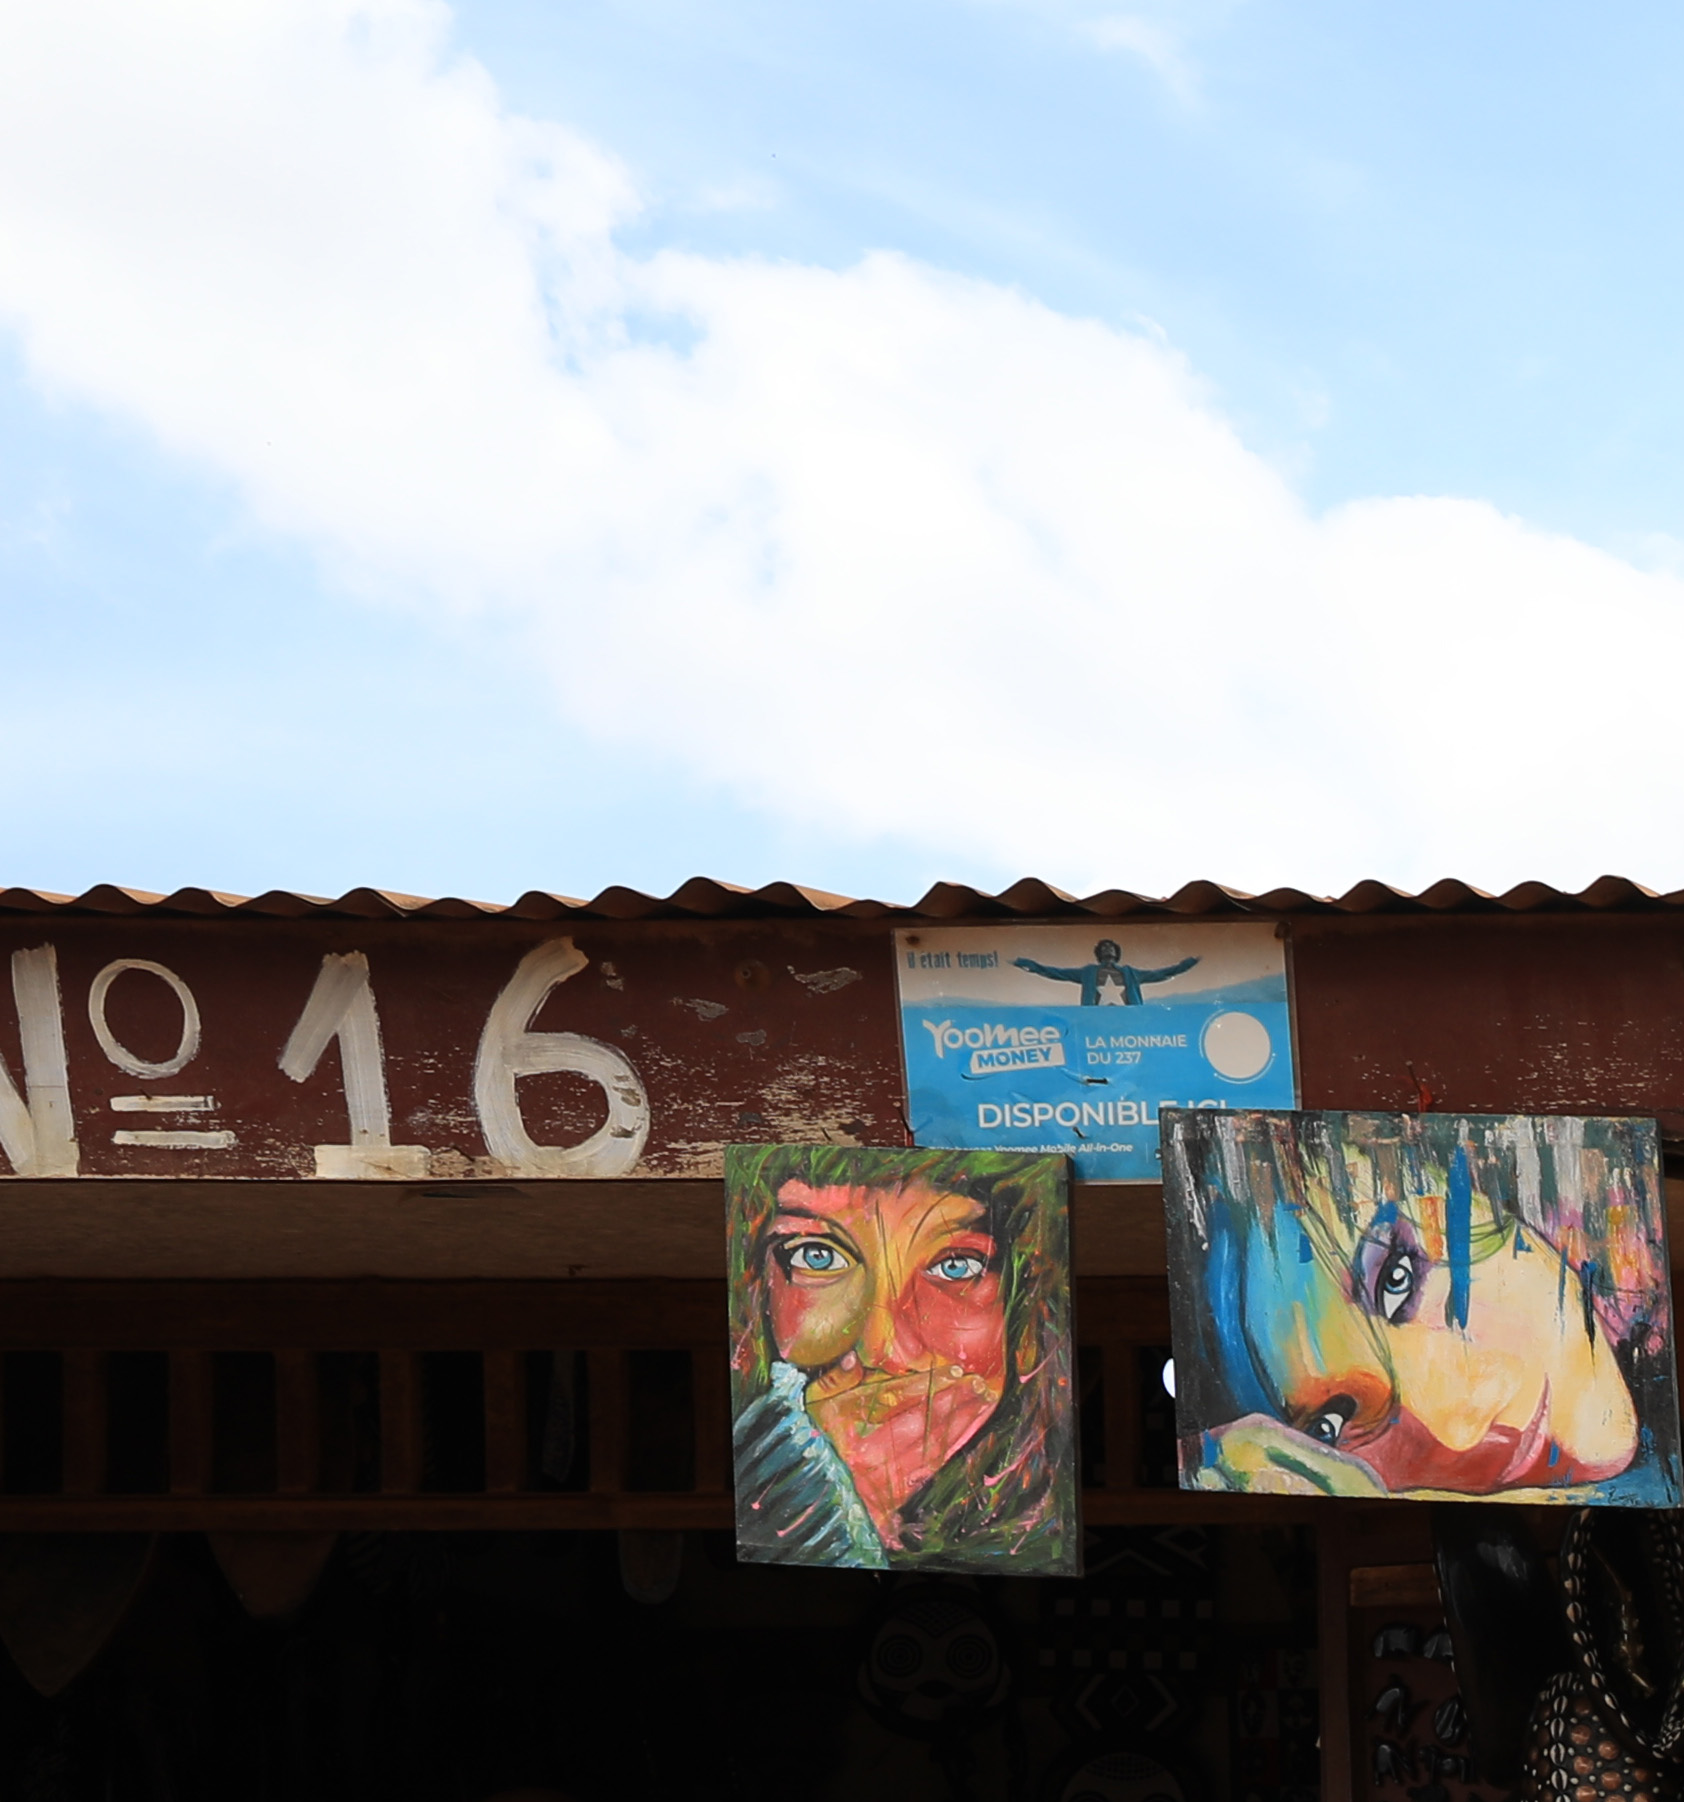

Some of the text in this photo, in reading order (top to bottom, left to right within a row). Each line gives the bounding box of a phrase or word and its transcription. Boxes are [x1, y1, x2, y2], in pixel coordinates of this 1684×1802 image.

[922, 1018, 1061, 1060] Yoomee
[1085, 1034, 1188, 1049] LA MONNAIE
[278, 936, 650, 1178] 16
[976, 1046, 1053, 1070] MONEY
[1088, 1051, 1141, 1065] DU 237
[1078, 1142, 1133, 1153] All-in-One
